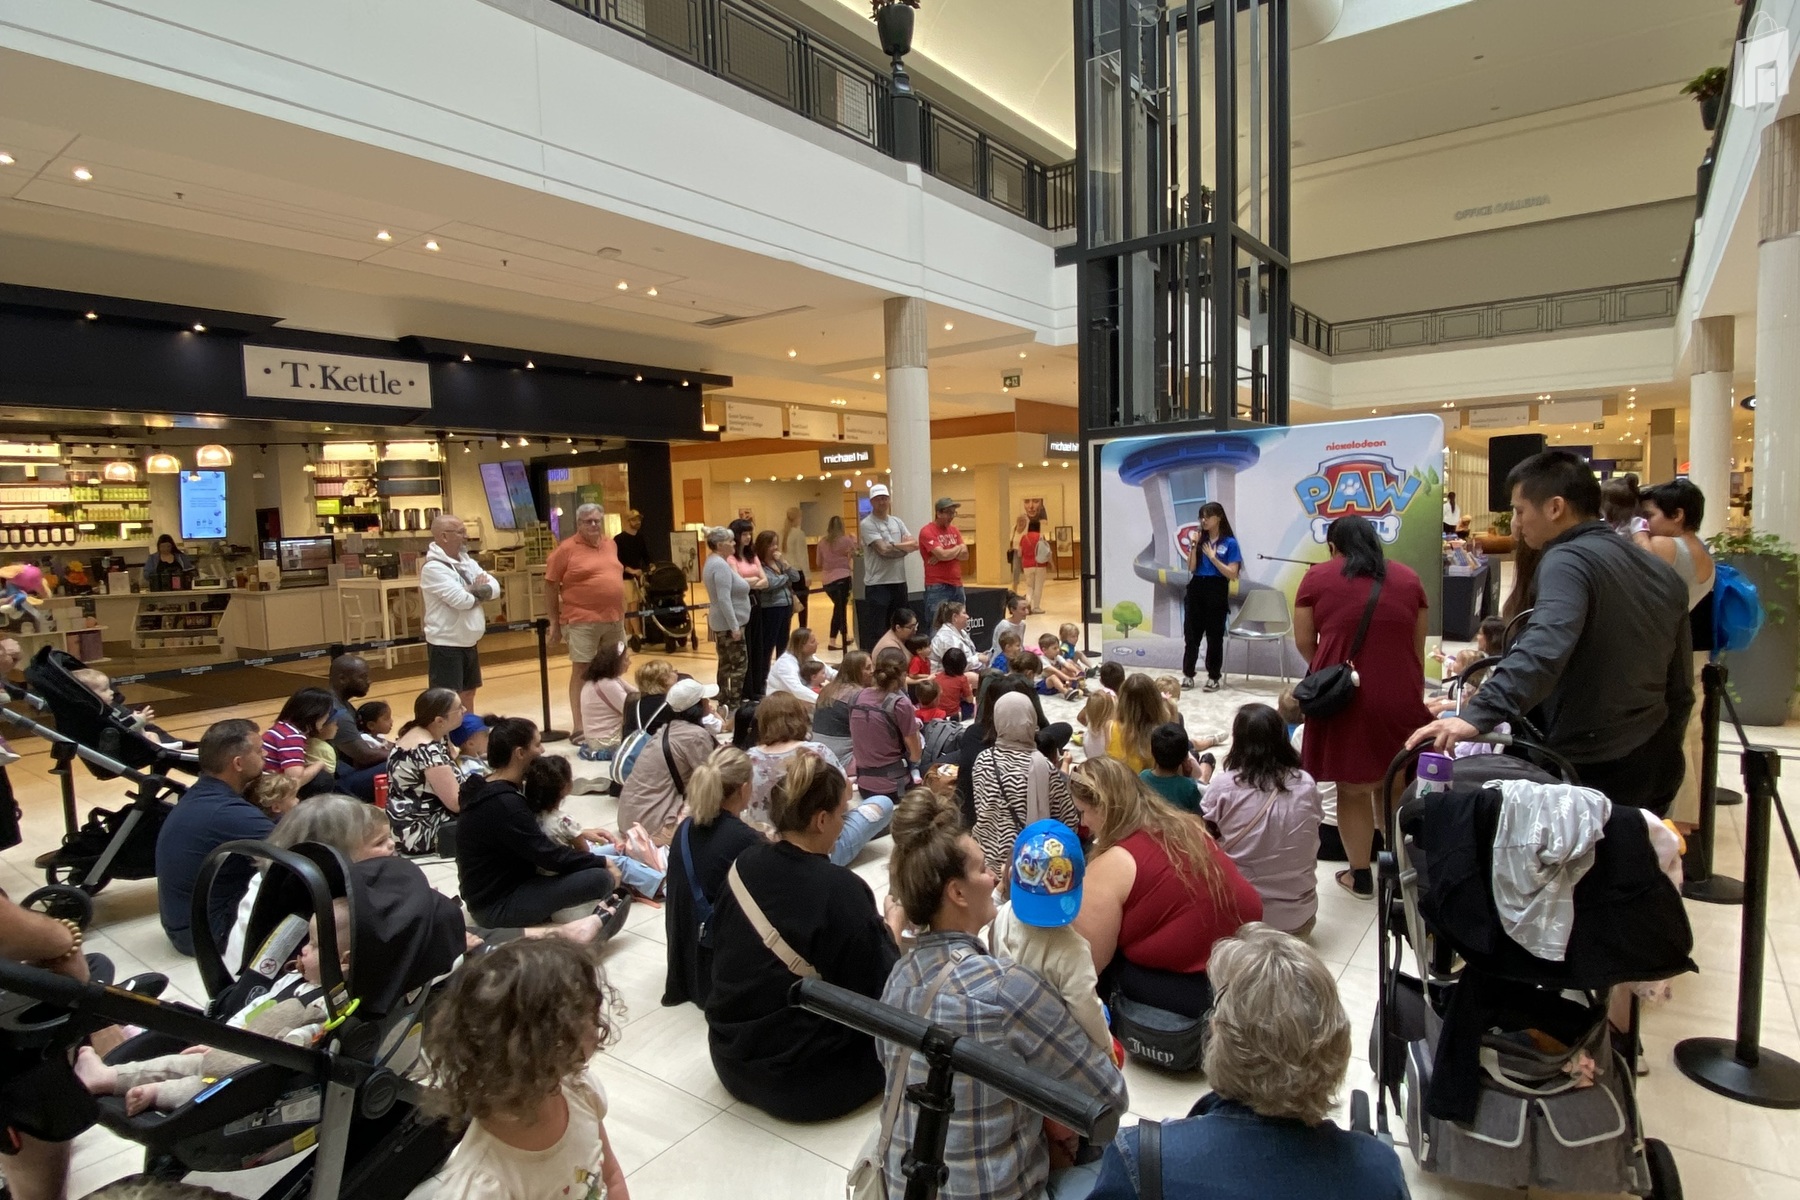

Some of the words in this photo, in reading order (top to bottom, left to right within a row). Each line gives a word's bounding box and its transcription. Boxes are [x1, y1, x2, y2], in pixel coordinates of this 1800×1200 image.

[1326, 440, 1387, 451] nickelodeon
[823, 453, 856, 464] michael
[856, 451, 869, 461] hill
[1294, 470, 1422, 518] PAW
[1127, 1036, 1175, 1067] Juicy
